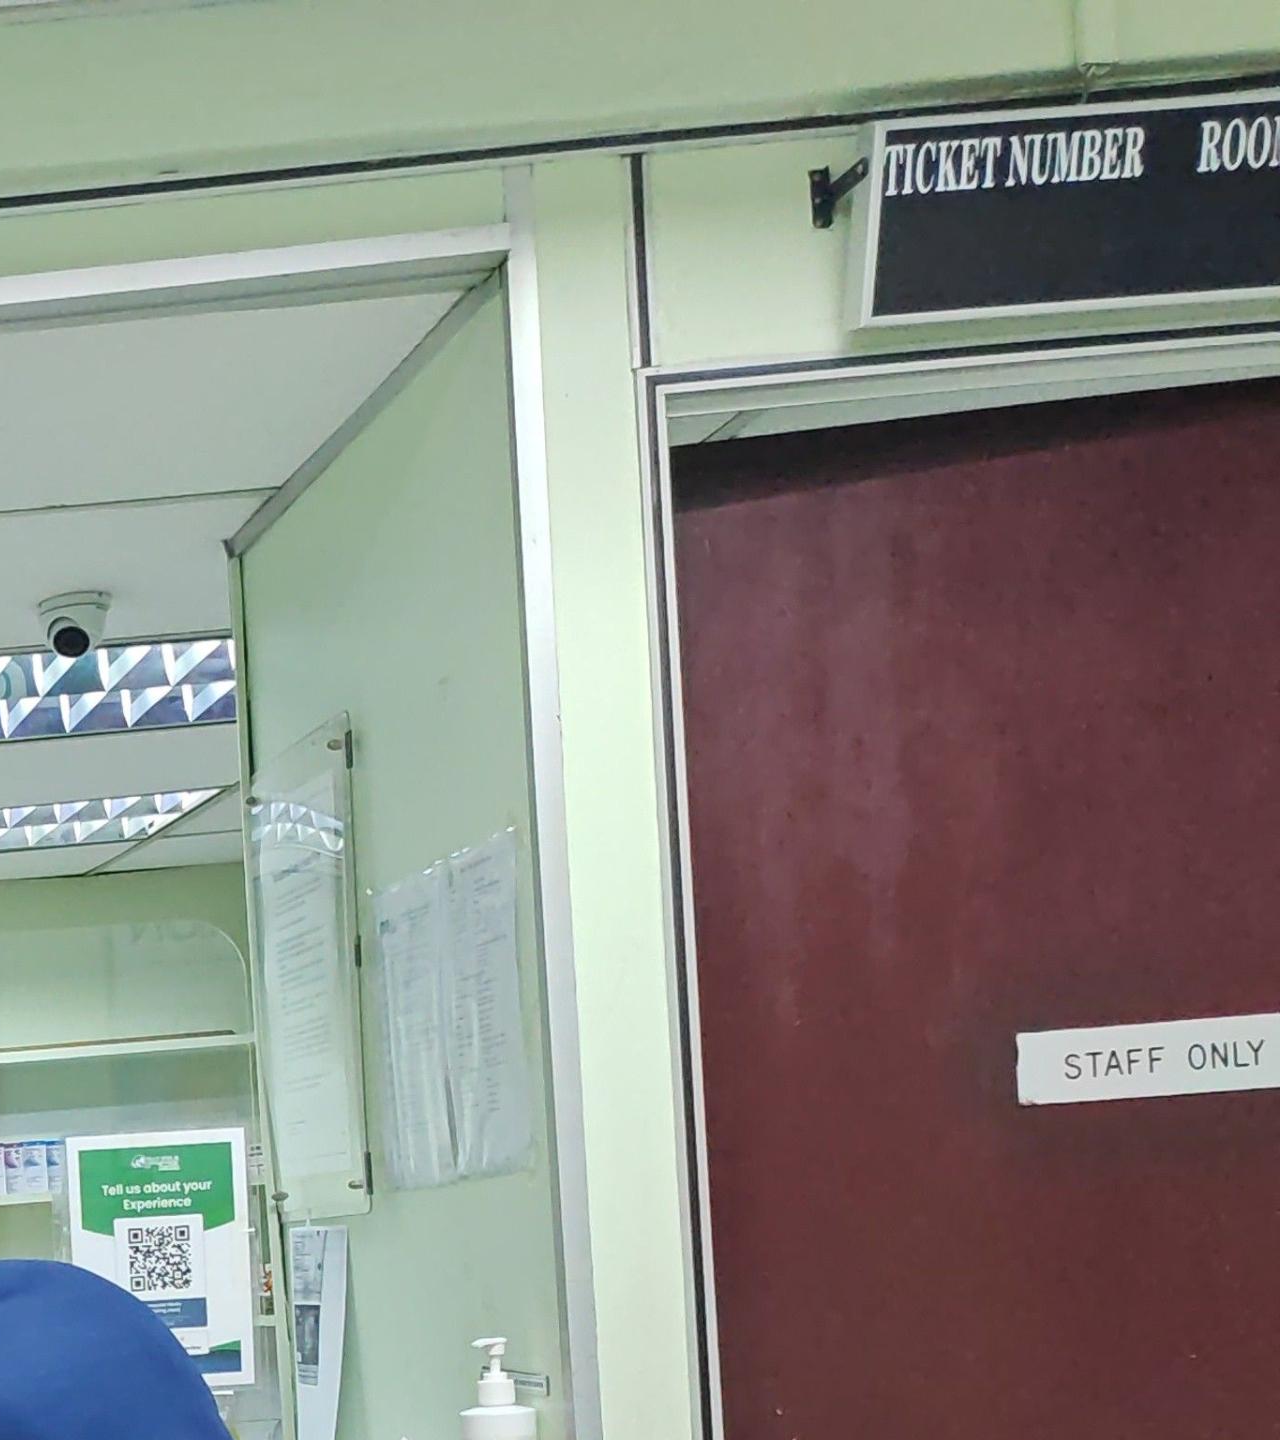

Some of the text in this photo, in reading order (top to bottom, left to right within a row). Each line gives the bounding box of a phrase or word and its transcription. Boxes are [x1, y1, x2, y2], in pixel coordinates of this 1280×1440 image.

[883, 126, 1145, 197] TICKET NUMBER
[1064, 1039, 1265, 1080] STAFF ONLY
[101, 1180, 213, 1197] Tell us about your
[123, 1197, 192, 1212] Experience
